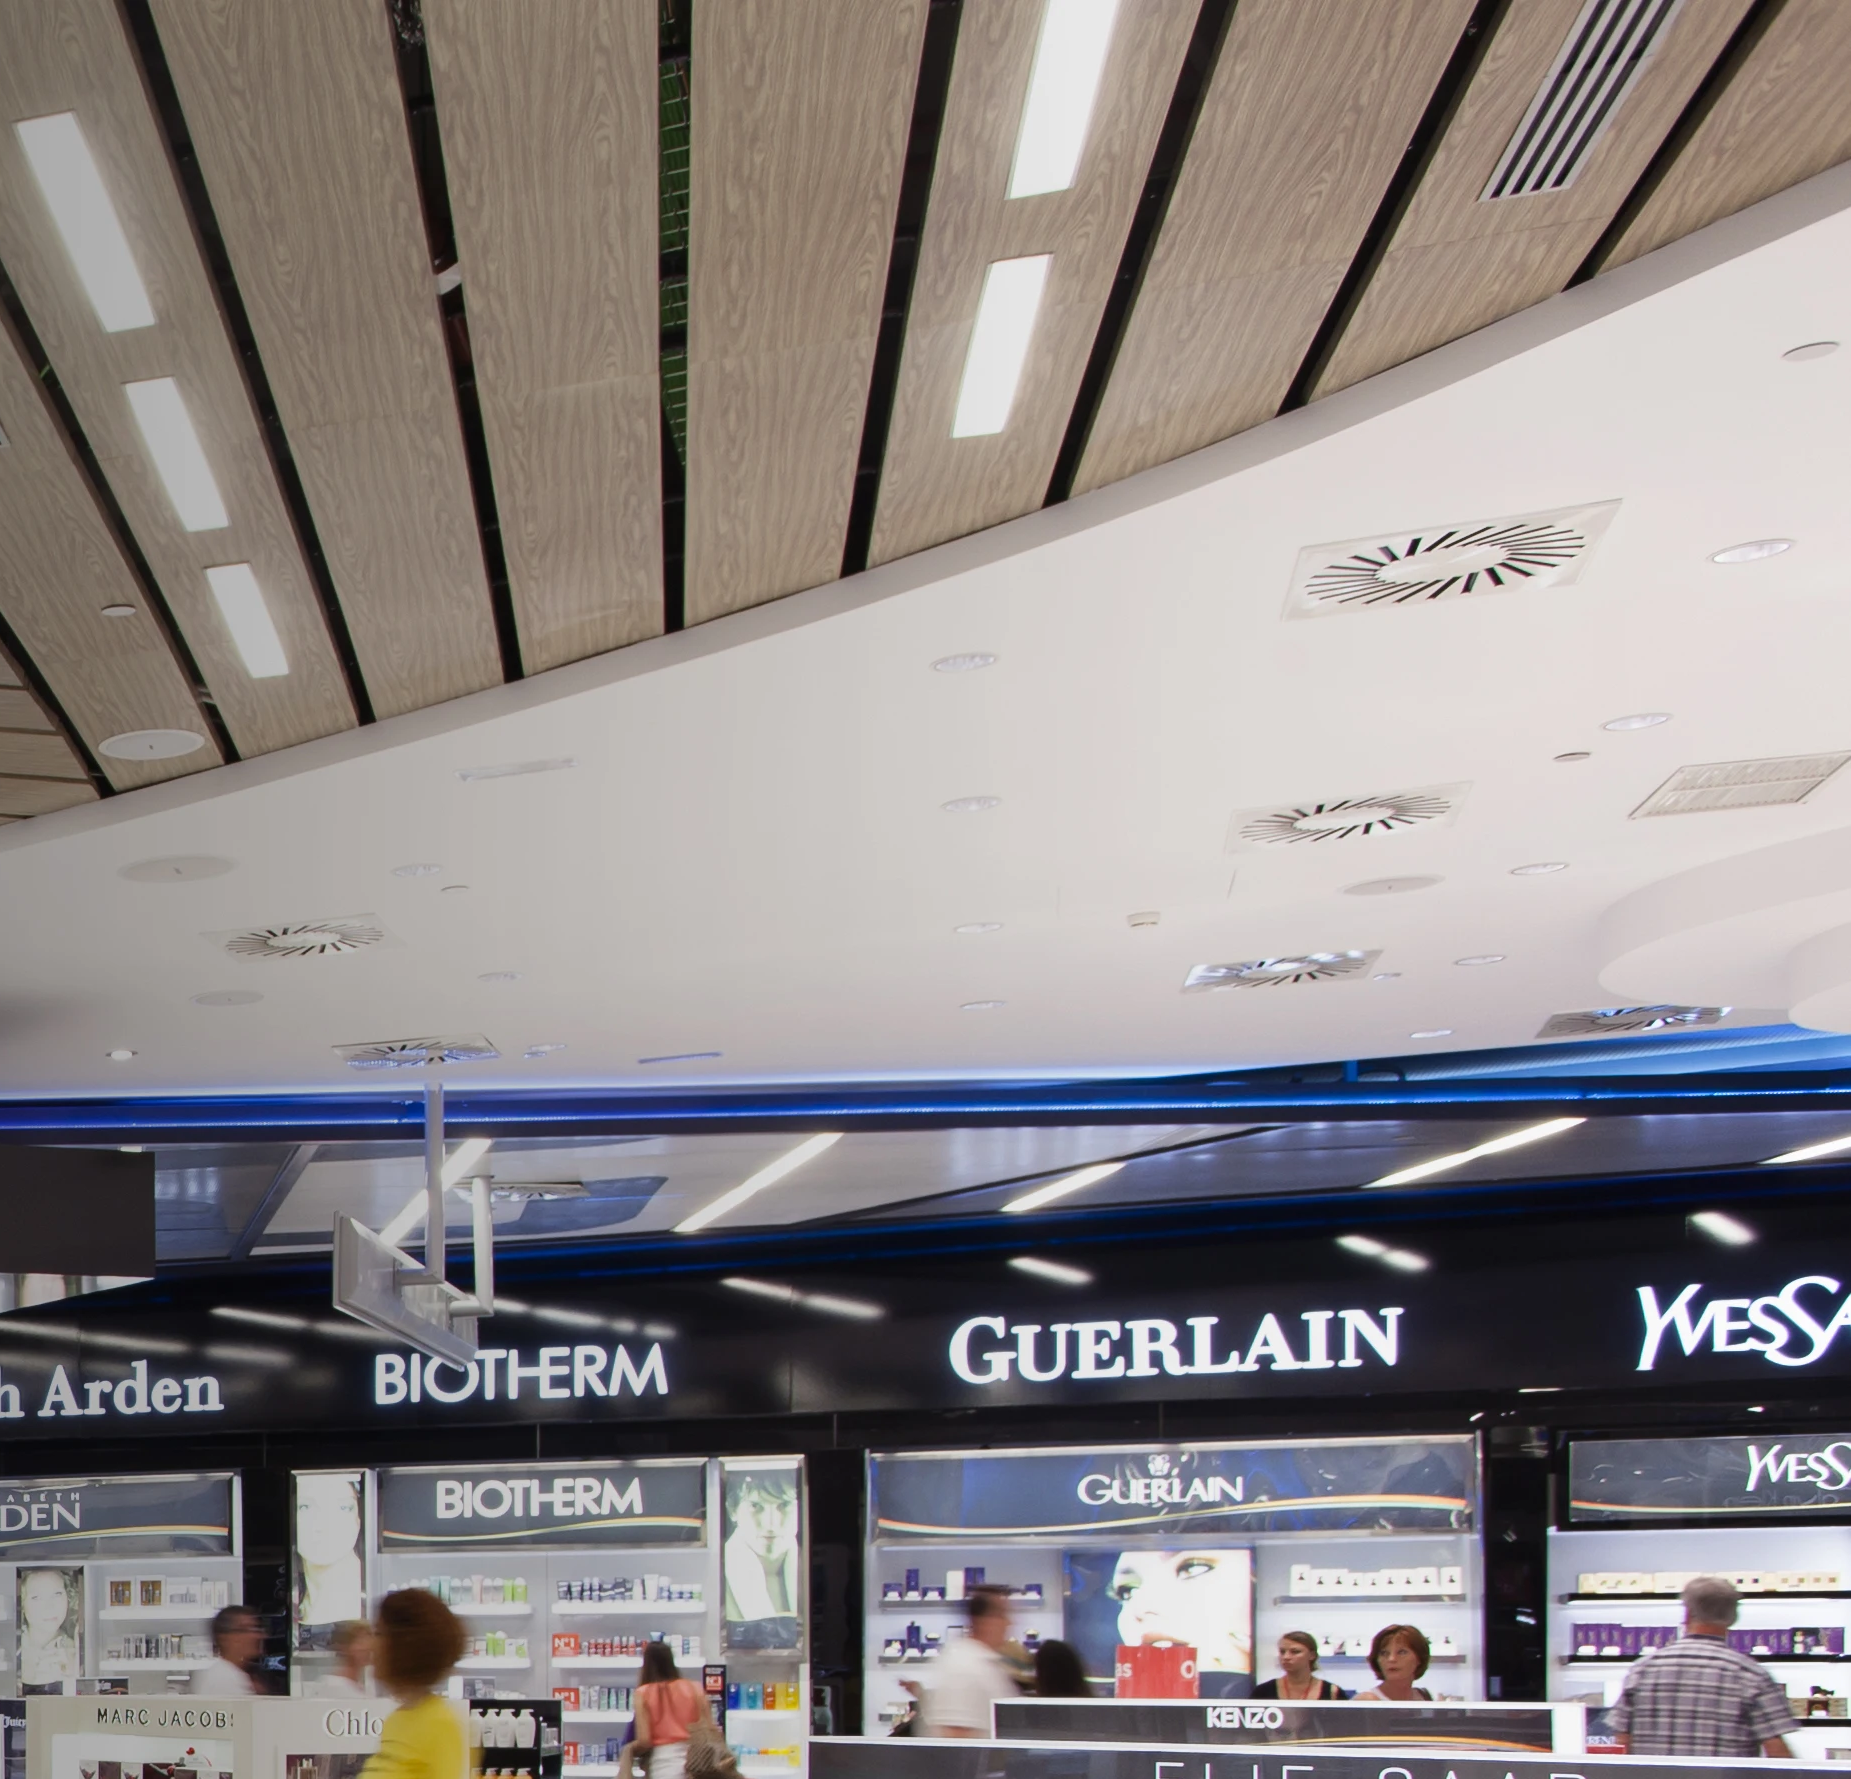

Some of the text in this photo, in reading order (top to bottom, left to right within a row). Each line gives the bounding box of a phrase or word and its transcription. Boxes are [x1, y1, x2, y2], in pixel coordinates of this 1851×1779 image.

[948, 1306, 1405, 1385] GUERLAIN
[38, 1360, 224, 1417] Arden
[375, 1342, 669, 1405] BIOTHERM
[436, 1477, 643, 1519] BIOTHERM
[1077, 1474, 1243, 1506] GUERLAIN
[97, 1708, 150, 1724] MARC
[323, 1709, 385, 1738] Chlo
[1207, 1707, 1283, 1730] KENZO
